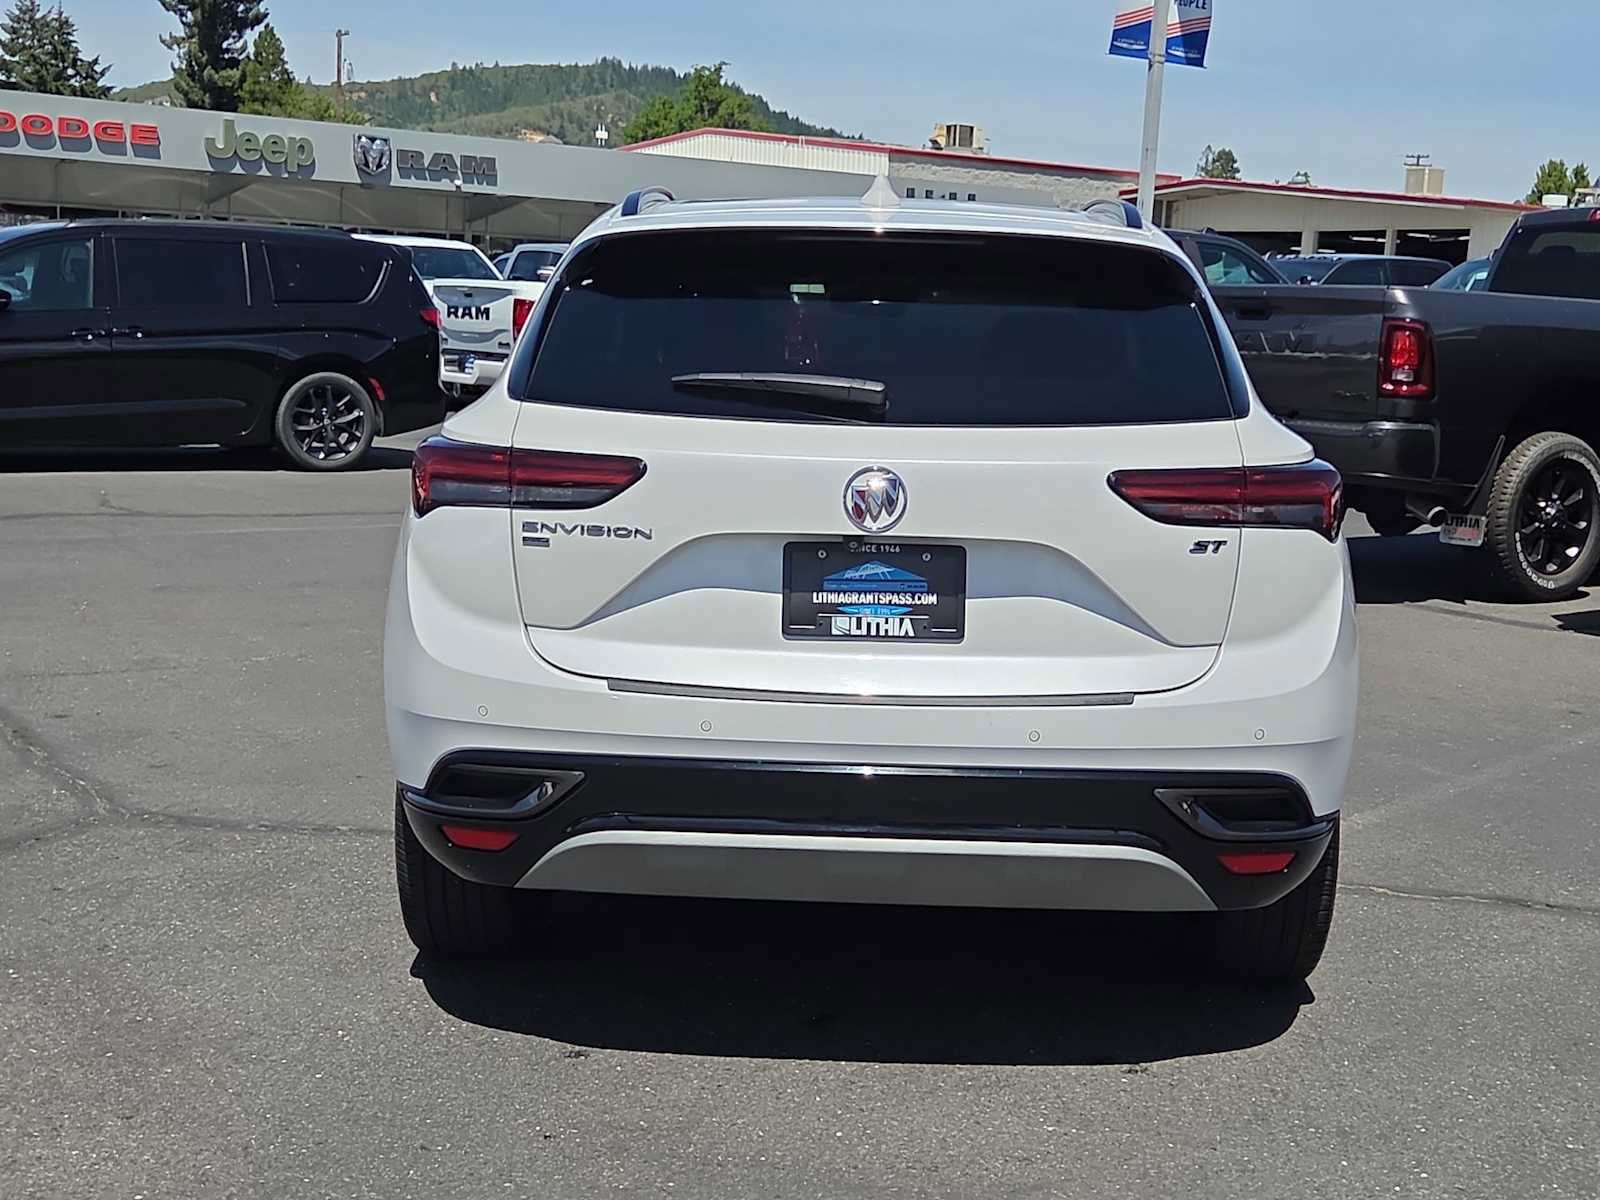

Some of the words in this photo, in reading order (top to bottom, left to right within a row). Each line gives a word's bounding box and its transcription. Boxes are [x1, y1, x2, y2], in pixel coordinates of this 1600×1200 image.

[205, 119, 314, 172] Jeep
[397, 149, 498, 176] RAM
[447, 305, 490, 321] RAM
[522, 521, 652, 541] ENVISION
[850, 544, 877, 553] NCE
[1189, 540, 1228, 554] ST
[812, 592, 937, 605] LITHIAGRANTSPASS.COM
[851, 617, 915, 637] LITHIA
